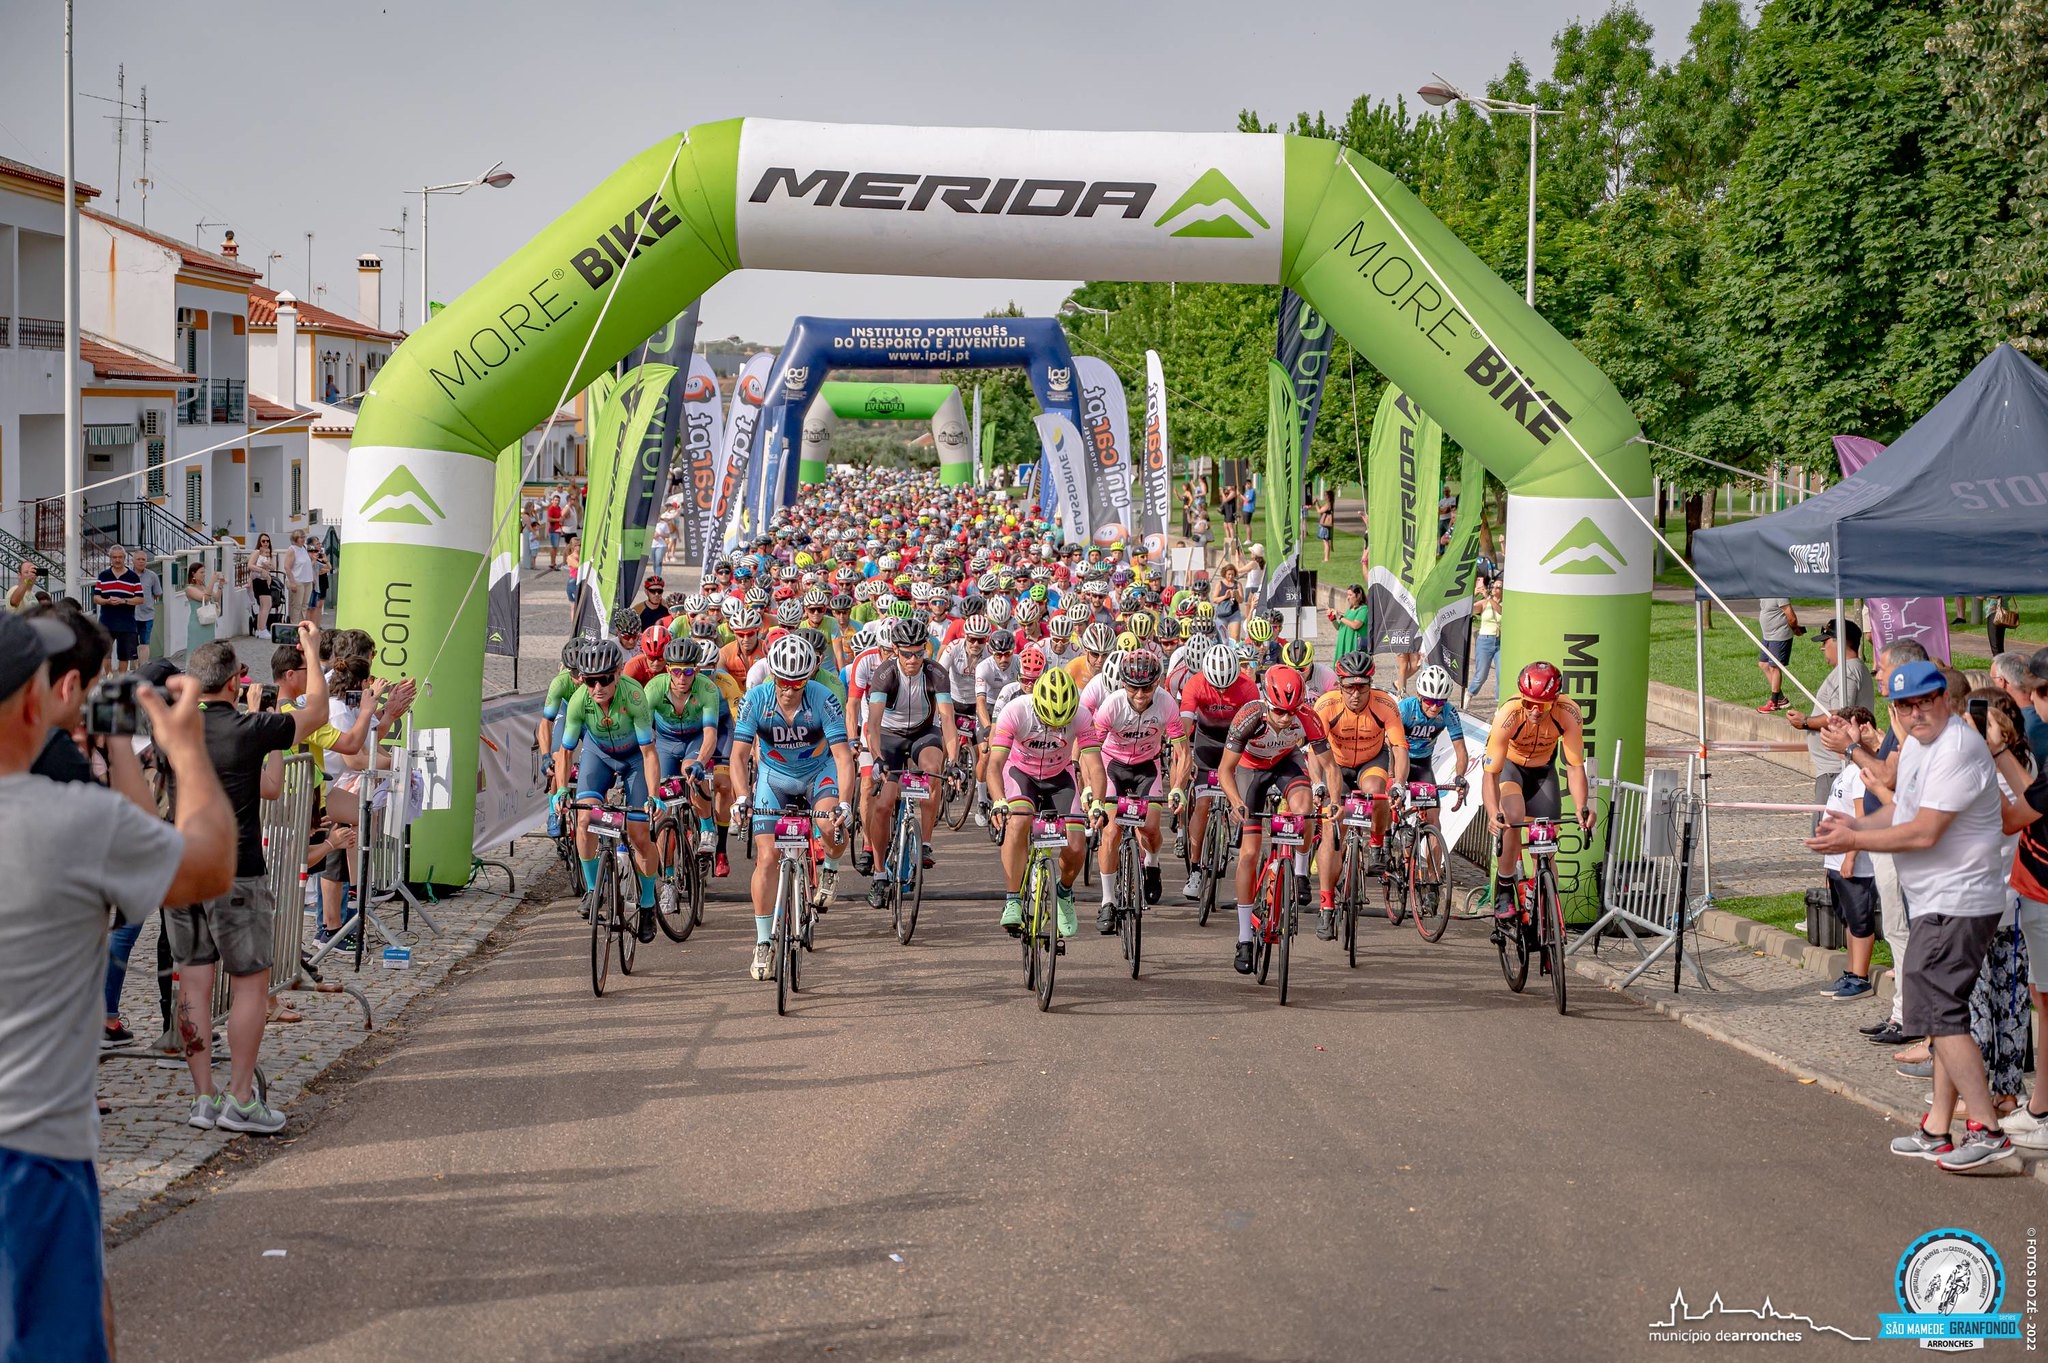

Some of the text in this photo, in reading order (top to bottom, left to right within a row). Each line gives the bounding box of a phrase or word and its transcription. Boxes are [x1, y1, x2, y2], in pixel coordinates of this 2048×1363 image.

[748, 167, 1157, 219] MERIDA
[570, 192, 682, 290] BIKE
[851, 325, 1008, 338] INSTITUTO PORTUGUÊS
[834, 336, 1026, 349] DO DESPORTO E JUVENTUDE
[888, 350, 970, 362] www.ipdj.pt
[1464, 344, 1573, 446] BIKE
[1400, 425, 1417, 585] MERIDA
[1390, 636, 1410, 645] BIKE
[773, 726, 809, 742] DAP
[1410, 725, 1436, 738] DAP
[1354, 805, 1364, 815] 74
[601, 812, 613, 823] 35
[1044, 823, 1056, 834] 49
